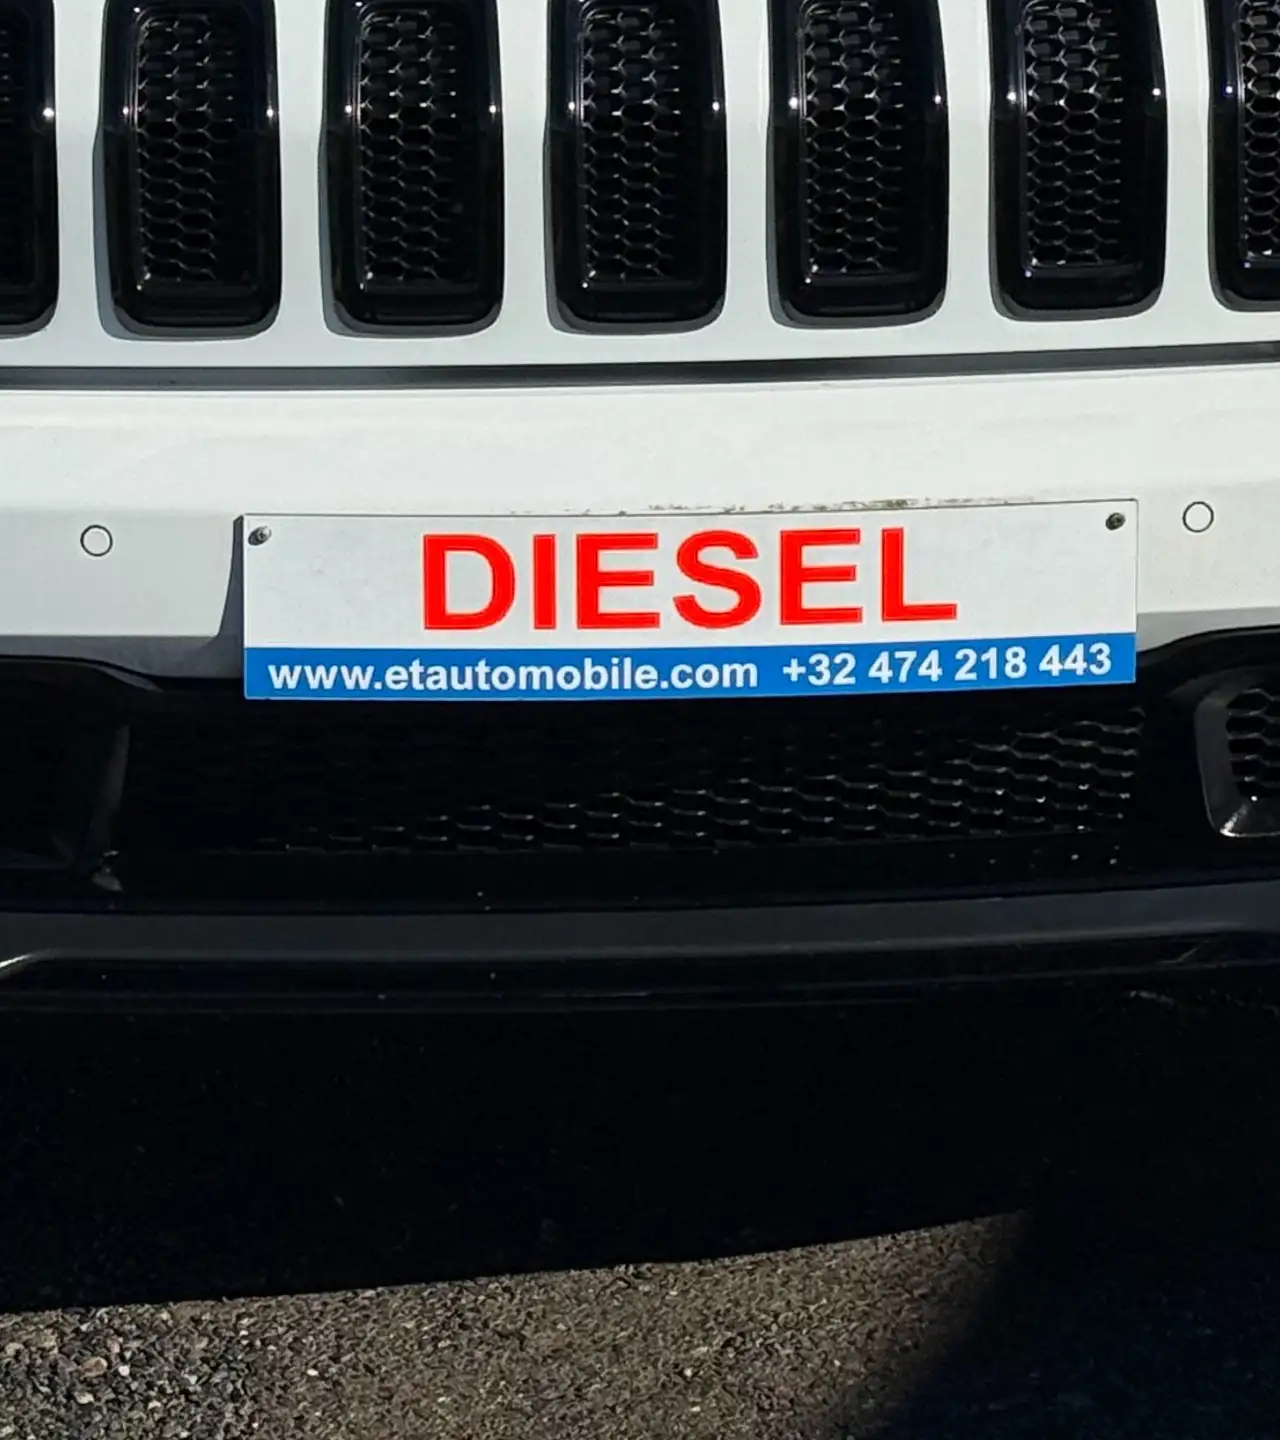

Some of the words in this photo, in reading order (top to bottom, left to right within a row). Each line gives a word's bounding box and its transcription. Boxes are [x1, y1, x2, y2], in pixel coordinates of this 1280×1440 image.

[423, 527, 958, 630] DIESEL
[267, 657, 758, 691] www.etautomobile.com
[783, 652, 856, 686] +32
[868, 649, 942, 685] 474
[954, 647, 1027, 681] 218
[1039, 642, 1112, 677] 443
